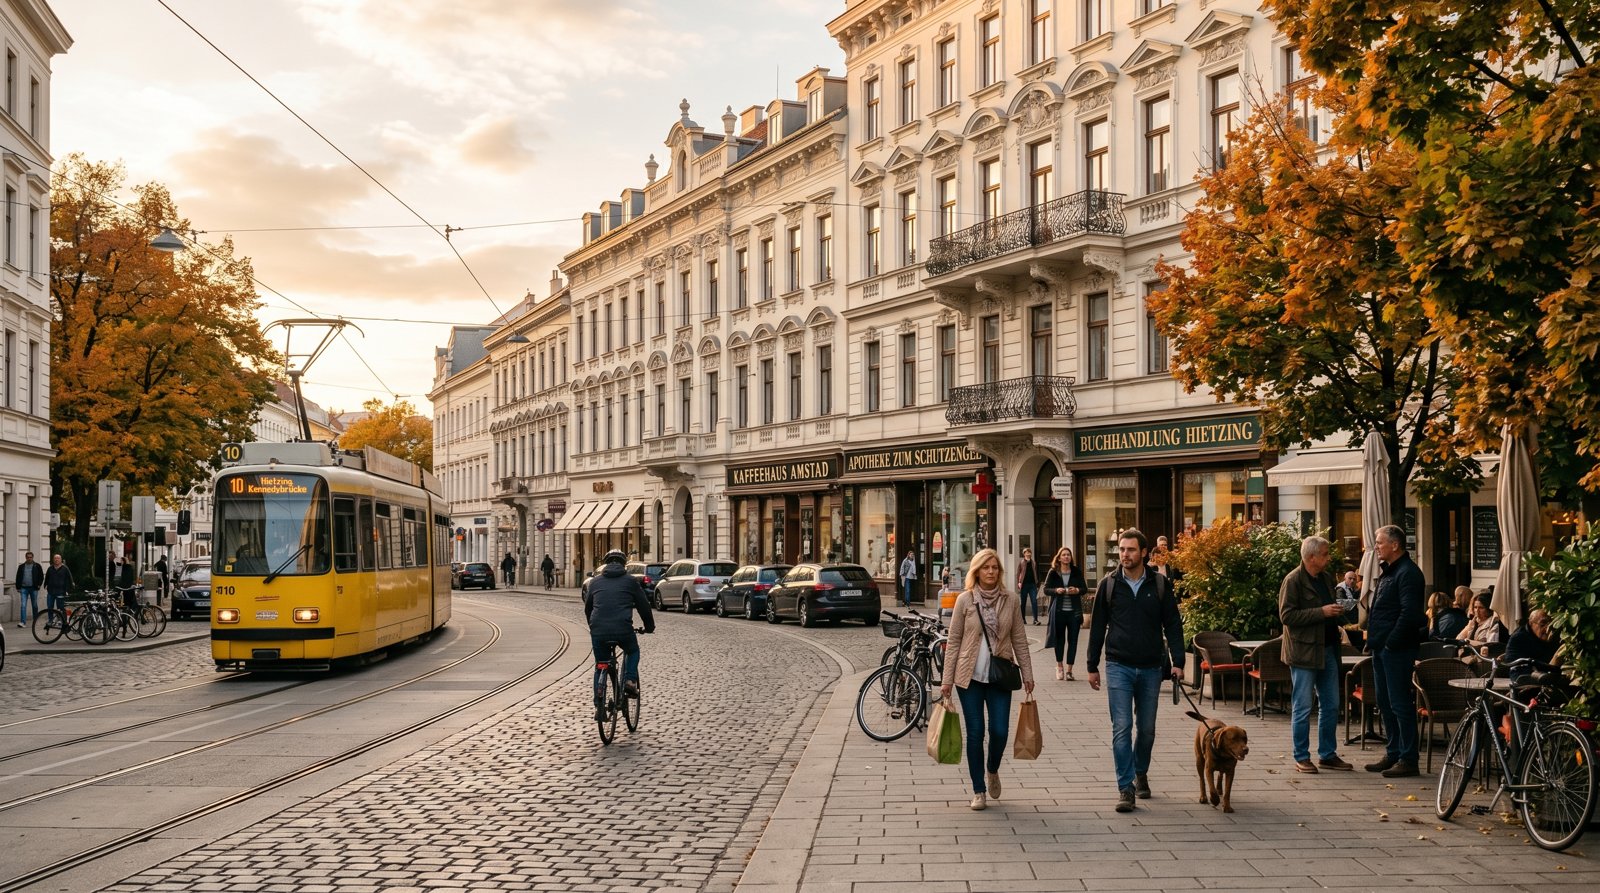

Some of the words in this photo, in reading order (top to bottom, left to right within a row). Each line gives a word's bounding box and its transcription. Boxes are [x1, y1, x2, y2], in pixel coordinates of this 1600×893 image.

[1080, 427, 1180, 452] BUCHHANDLUNG
[1186, 421, 1253, 444] HIETZING
[224, 446, 240, 460] 10
[848, 452, 891, 470] APOTHEKE
[893, 450, 912, 467] ZUM
[733, 465, 787, 484] KAFFEEHAUS
[790, 461, 829, 480] AMSTAD
[230, 477, 244, 493] 10
[248, 484, 307, 494] Kennedybrücke
